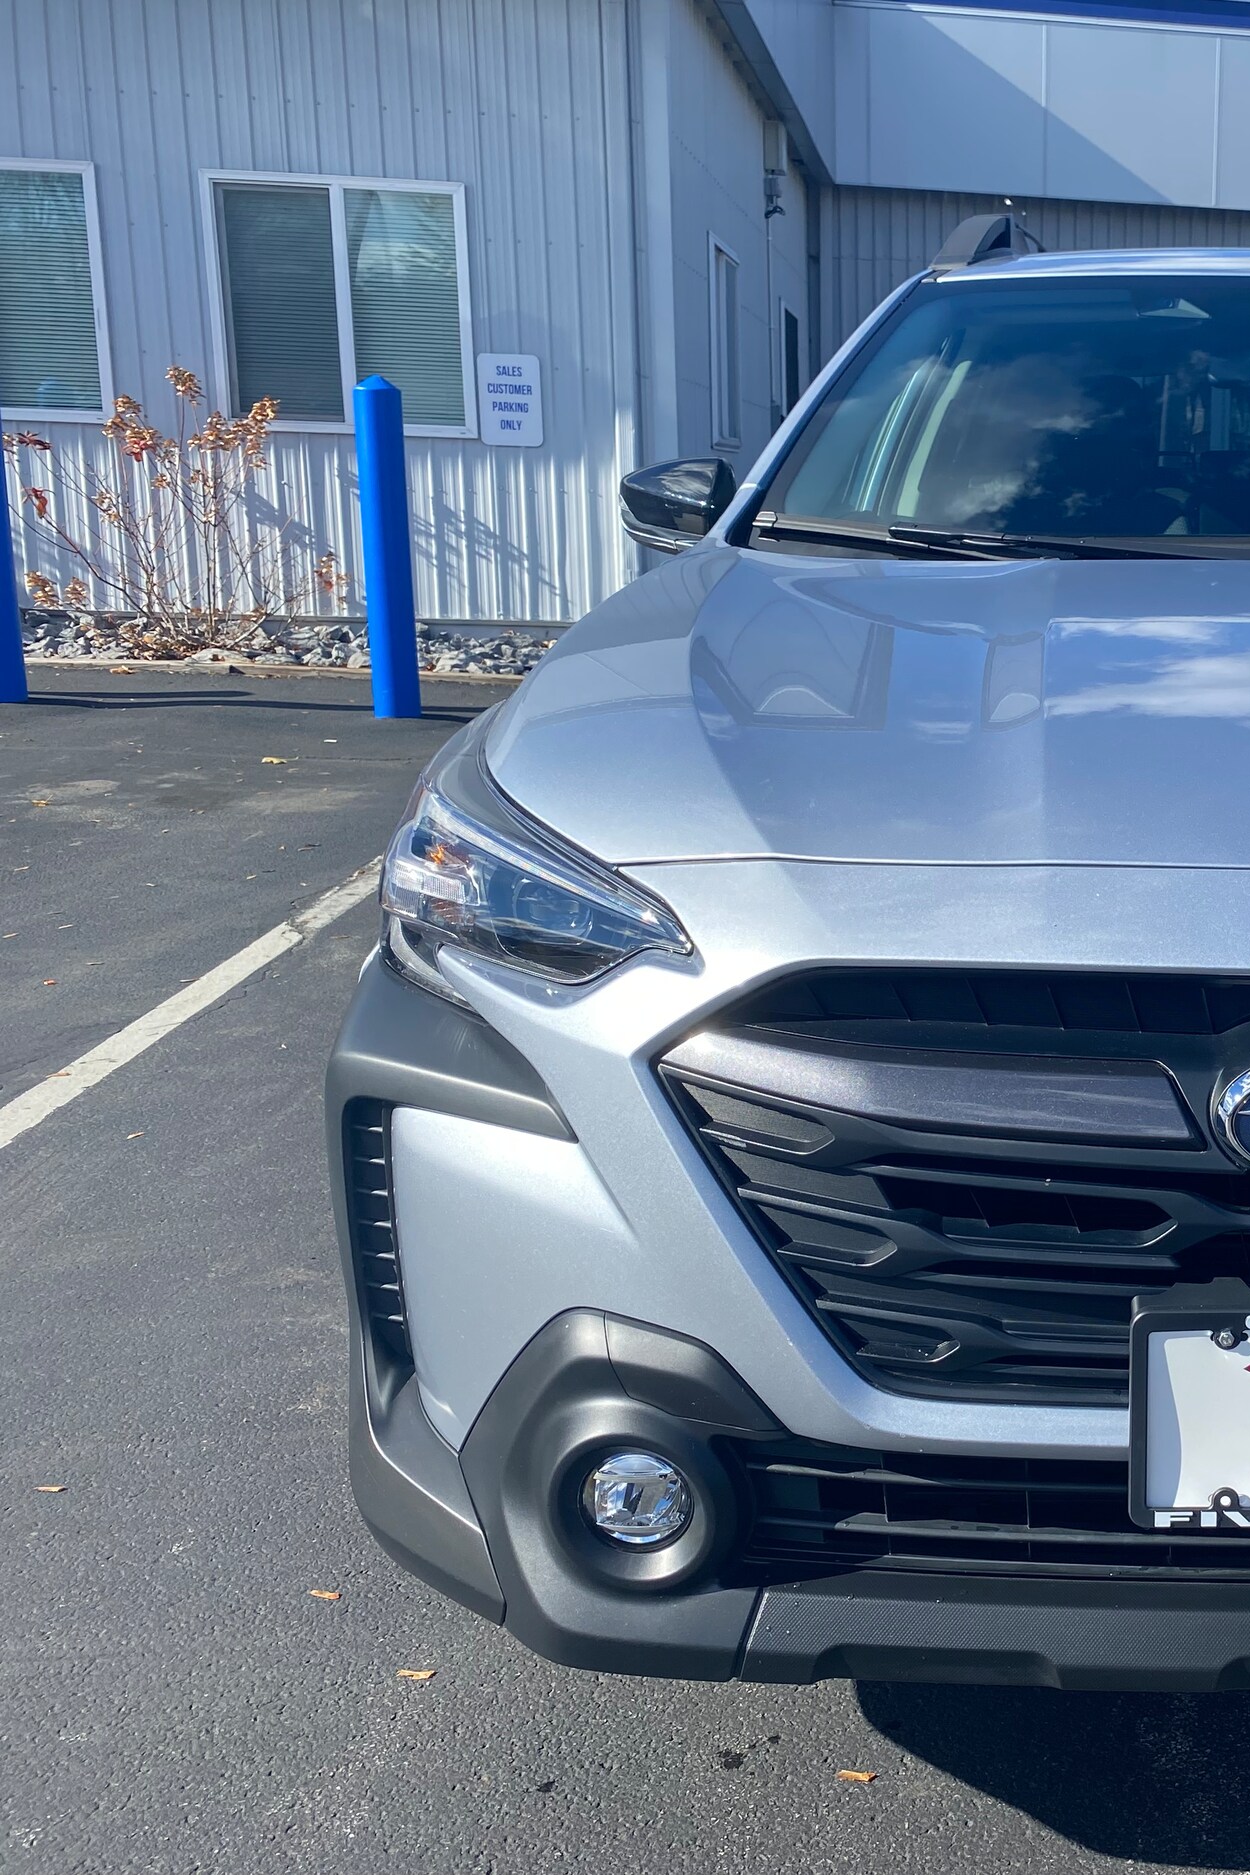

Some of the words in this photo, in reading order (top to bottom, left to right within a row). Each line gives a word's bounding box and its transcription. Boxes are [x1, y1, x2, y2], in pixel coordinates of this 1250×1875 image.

[496, 365, 522, 377] SALES
[487, 383, 532, 395] CUSTOMER
[492, 401, 529, 413] PARKING
[500, 419, 522, 430] ONLY
